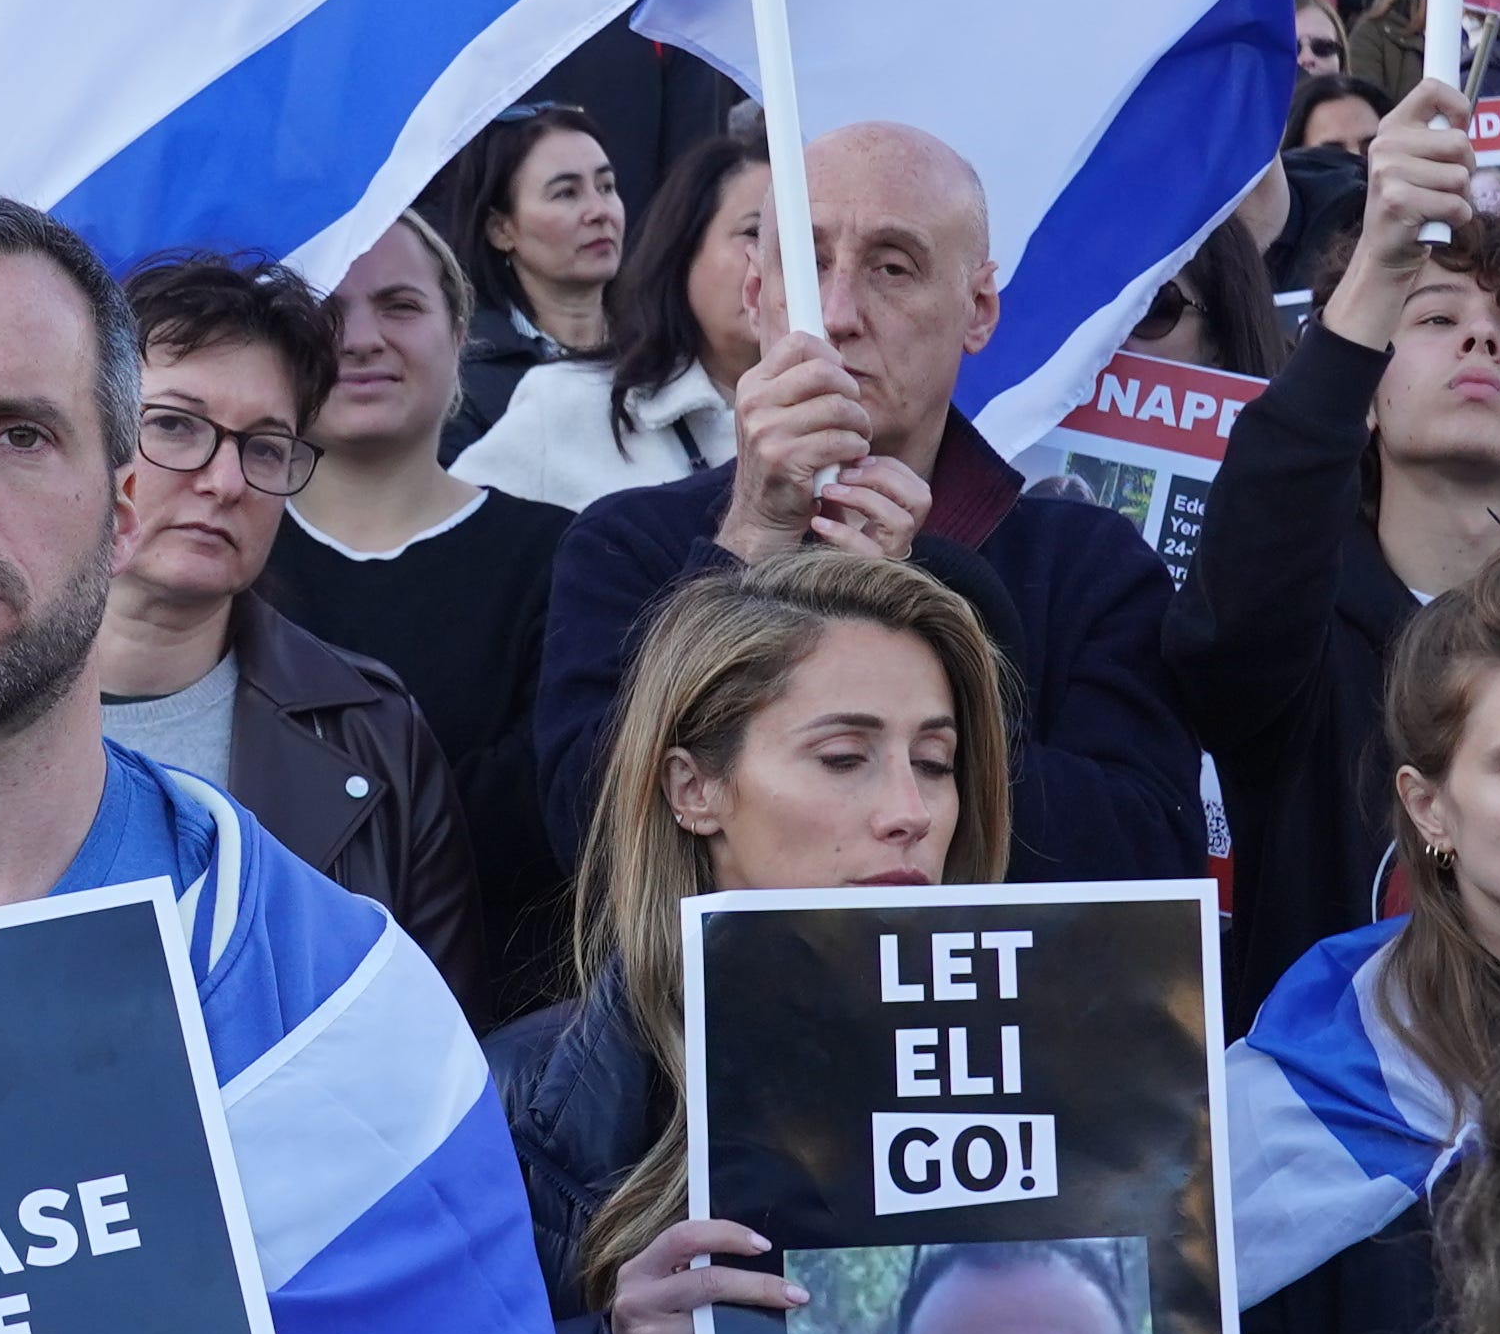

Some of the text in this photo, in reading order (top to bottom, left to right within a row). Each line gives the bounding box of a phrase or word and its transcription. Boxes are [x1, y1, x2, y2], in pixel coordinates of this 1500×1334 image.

[879, 930, 1034, 1002] LET
[895, 1025, 1021, 1098] ELI
[887, 1122, 1036, 1195] GO!
